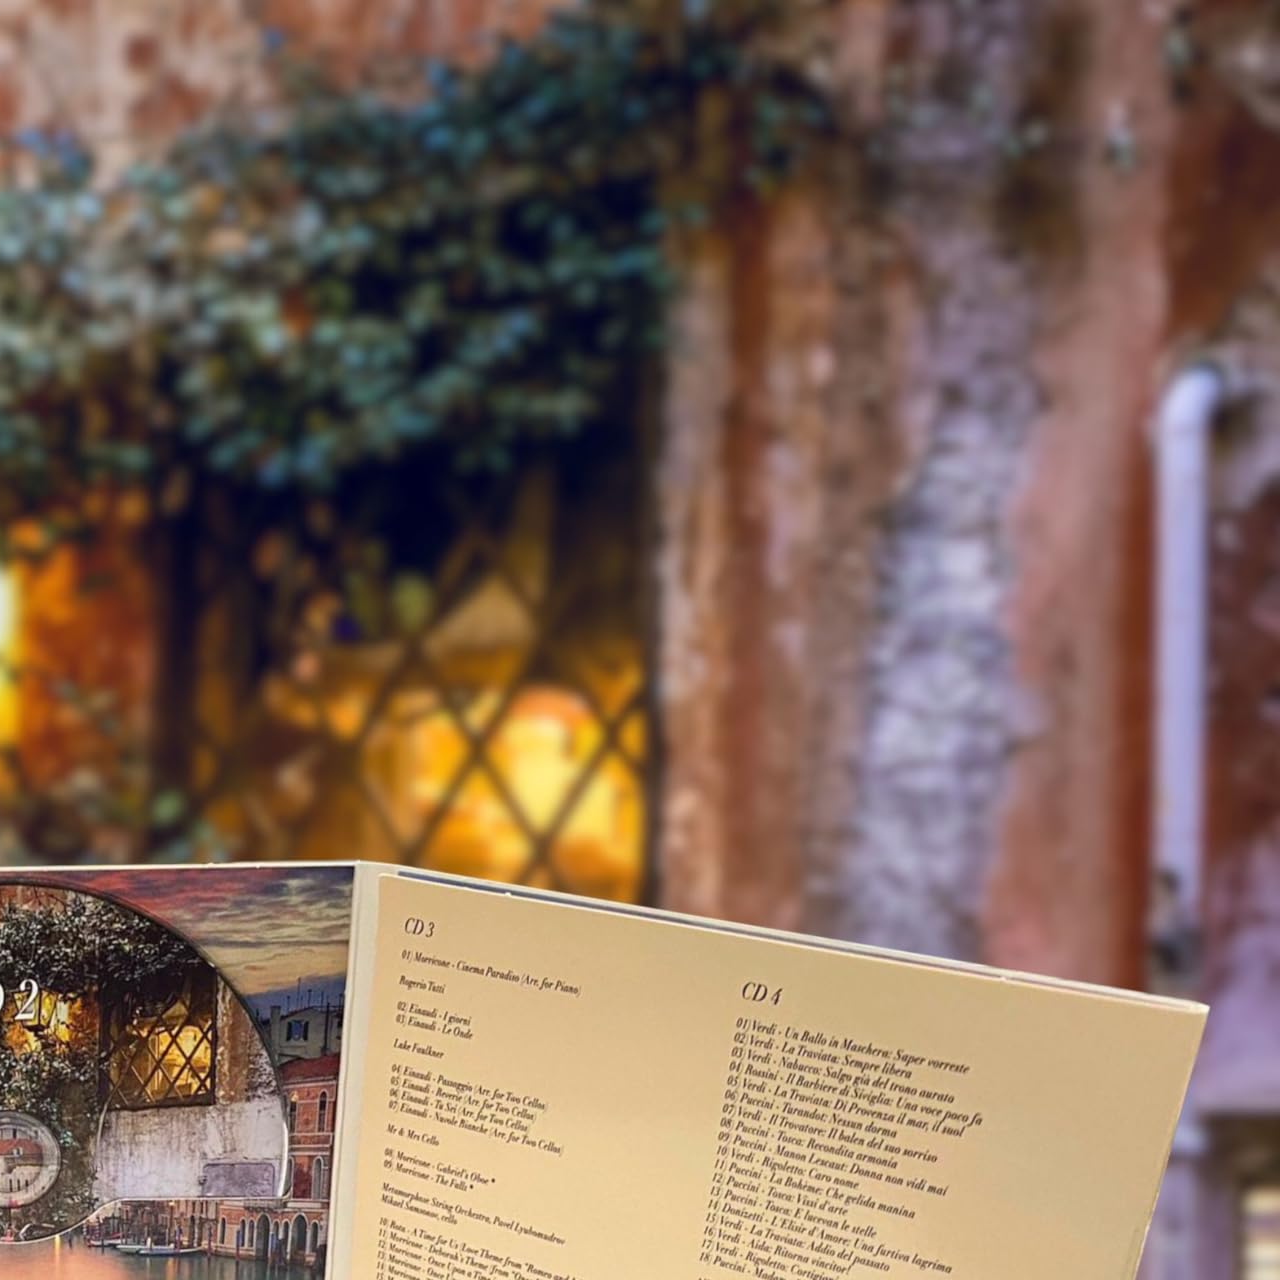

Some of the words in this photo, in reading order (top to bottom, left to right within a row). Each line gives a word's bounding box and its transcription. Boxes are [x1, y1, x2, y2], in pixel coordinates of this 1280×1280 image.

[404, 917, 424, 934] CD
[425, 921, 434, 937] 3
[14, 979, 39, 1020] 2
[742, 981, 767, 1001] CD
[770, 988, 782, 1005] 4
[749, 1034, 774, 1049] Verdi
[780, 1041, 795, 1054] La
[841, 1054, 880, 1072] Sempre
[881, 1061, 911, 1078] libera
[752, 1019, 777, 1035] Verdi
[784, 1026, 799, 1040] Un
[800, 1030, 826, 1045] Ballo
[828, 1036, 838, 1048] in
[893, 1049, 925, 1065] Saper
[744, 1063, 779, 1080] Rossini
[784, 1072, 796, 1084] Il
[795, 1075, 841, 1094] Barbiere
[838, 1083, 852, 1096] di
[896, 1096, 918, 1111] Una
[920, 1105, 942, 1116] voce
[941, 1110, 968, 1124] poco
[968, 1112, 982, 1126] fa
[747, 1048, 772, 1064] Verdi
[823, 1066, 852, 1084] Salgo
[871, 1075, 890, 1089] del
[889, 1081, 917, 1095] trono
[918, 1090, 954, 1103] aurato
[739, 1092, 775, 1109] Puccini
[828, 1112, 862, 1130] Nessun
[864, 1121, 897, 1138] dorma
[742, 1077, 767, 1093] Verdi
[773, 1084, 787, 1098] La
[833, 1098, 848, 1111] Di
[847, 1102, 895, 1122] Provenza
[896, 1112, 907, 1124] il
[905, 1118, 928, 1132] mar,
[931, 1120, 943, 1132] il
[941, 1125, 966, 1136] suol
[734, 1120, 770, 1137] Puccini
[806, 1137, 854, 1158] Recondita
[855, 1153, 897, 1168] armonia
[737, 1105, 762, 1121] Verdi
[768, 1113, 779, 1125] Il
[827, 1126, 838, 1139] Il
[837, 1129, 864, 1146] balen
[866, 1136, 884, 1150] del
[883, 1144, 900, 1154] suo
[902, 1148, 937, 1162] sorriso
[732, 1134, 767, 1151] Puccini
[773, 1144, 806, 1161] Manon
[849, 1162, 882, 1180] Donna
[884, 1174, 903, 1185] non
[906, 1177, 926, 1190] vidi
[926, 1185, 948, 1195] mai
[728, 1161, 762, 1179] Puccini
[768, 1171, 782, 1185] La
[825, 1186, 844, 1200] Che
[844, 1193, 875, 1208] gelida
[877, 1203, 915, 1218] manina
[715, 1241, 739, 1257] Verdi
[719, 1215, 743, 1230] Verdi
[749, 1224, 765, 1236] La
[806, 1240, 835, 1256] Addio
[836, 1248, 853, 1261] del
[851, 1256, 889, 1271] passato
[721, 1202, 764, 1222] Donizetti
[853, 1237, 874, 1252] Una
[874, 1244, 909, 1261] furtiva
[911, 1253, 951, 1273] lagrima
[713, 1255, 746, 1272] Puccini
